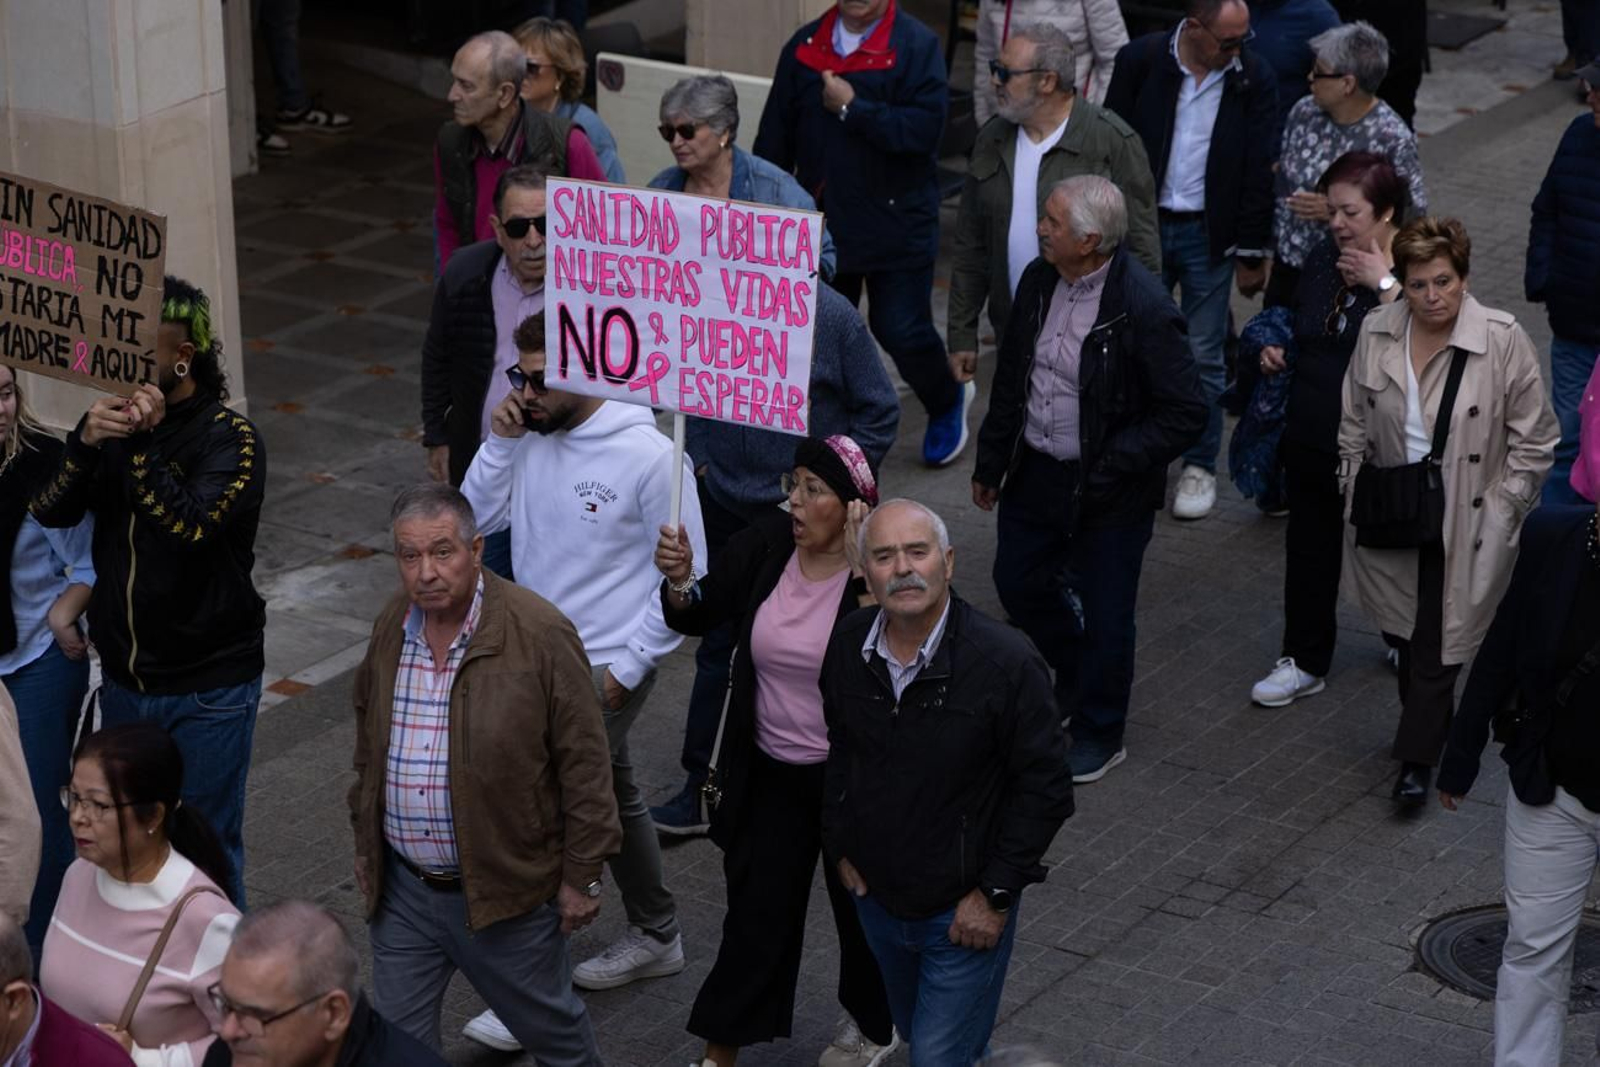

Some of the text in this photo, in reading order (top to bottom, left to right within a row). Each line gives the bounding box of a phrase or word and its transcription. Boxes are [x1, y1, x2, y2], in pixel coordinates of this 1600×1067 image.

[47, 193, 162, 260] SANIDAD
[553, 187, 680, 255] SANIDAD
[96, 255, 144, 301] NO
[554, 245, 811, 327] NUESTRAS VIDAS
[101, 304, 145, 347] MI
[558, 303, 788, 386] NO PUEDEN
[90, 344, 157, 386] AQUÍ
[678, 368, 806, 432] ESPERAR
